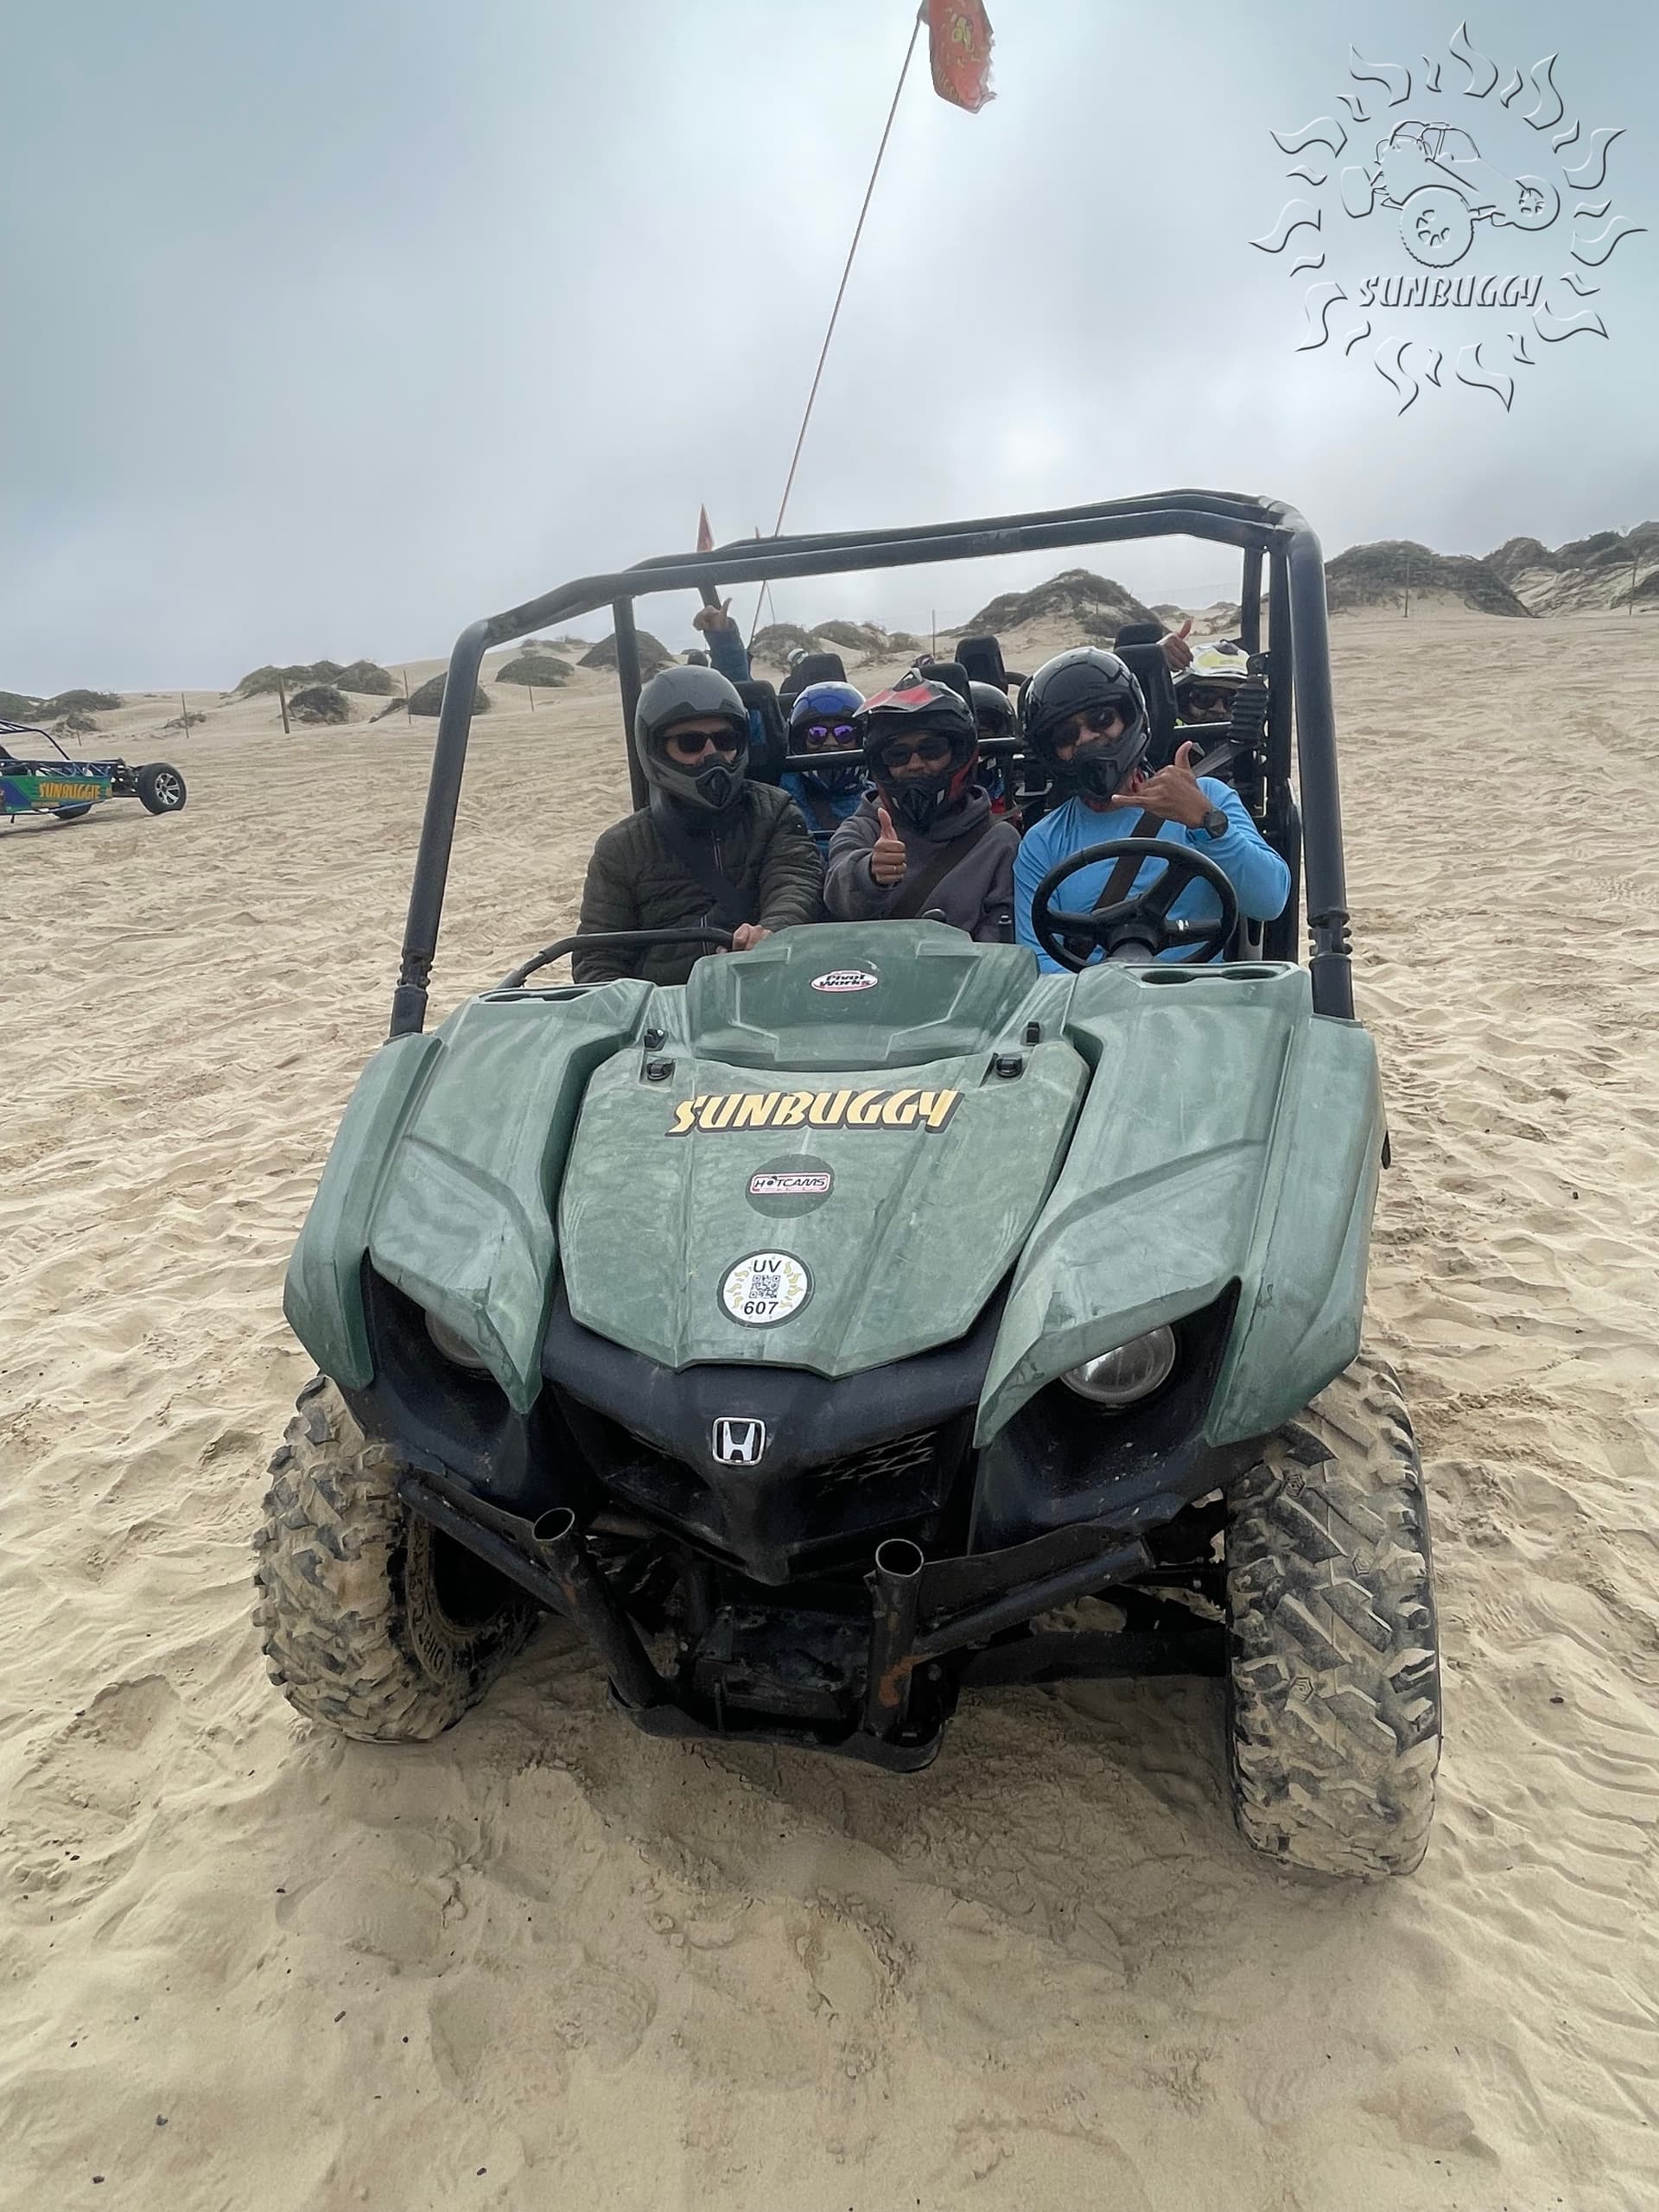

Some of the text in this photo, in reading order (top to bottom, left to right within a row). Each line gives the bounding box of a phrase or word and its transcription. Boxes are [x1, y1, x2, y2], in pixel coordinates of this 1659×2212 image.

[667, 1090, 963, 1135] SUNBUGGY
[753, 1259, 782, 1273] UV
[743, 1300, 779, 1315] 607
